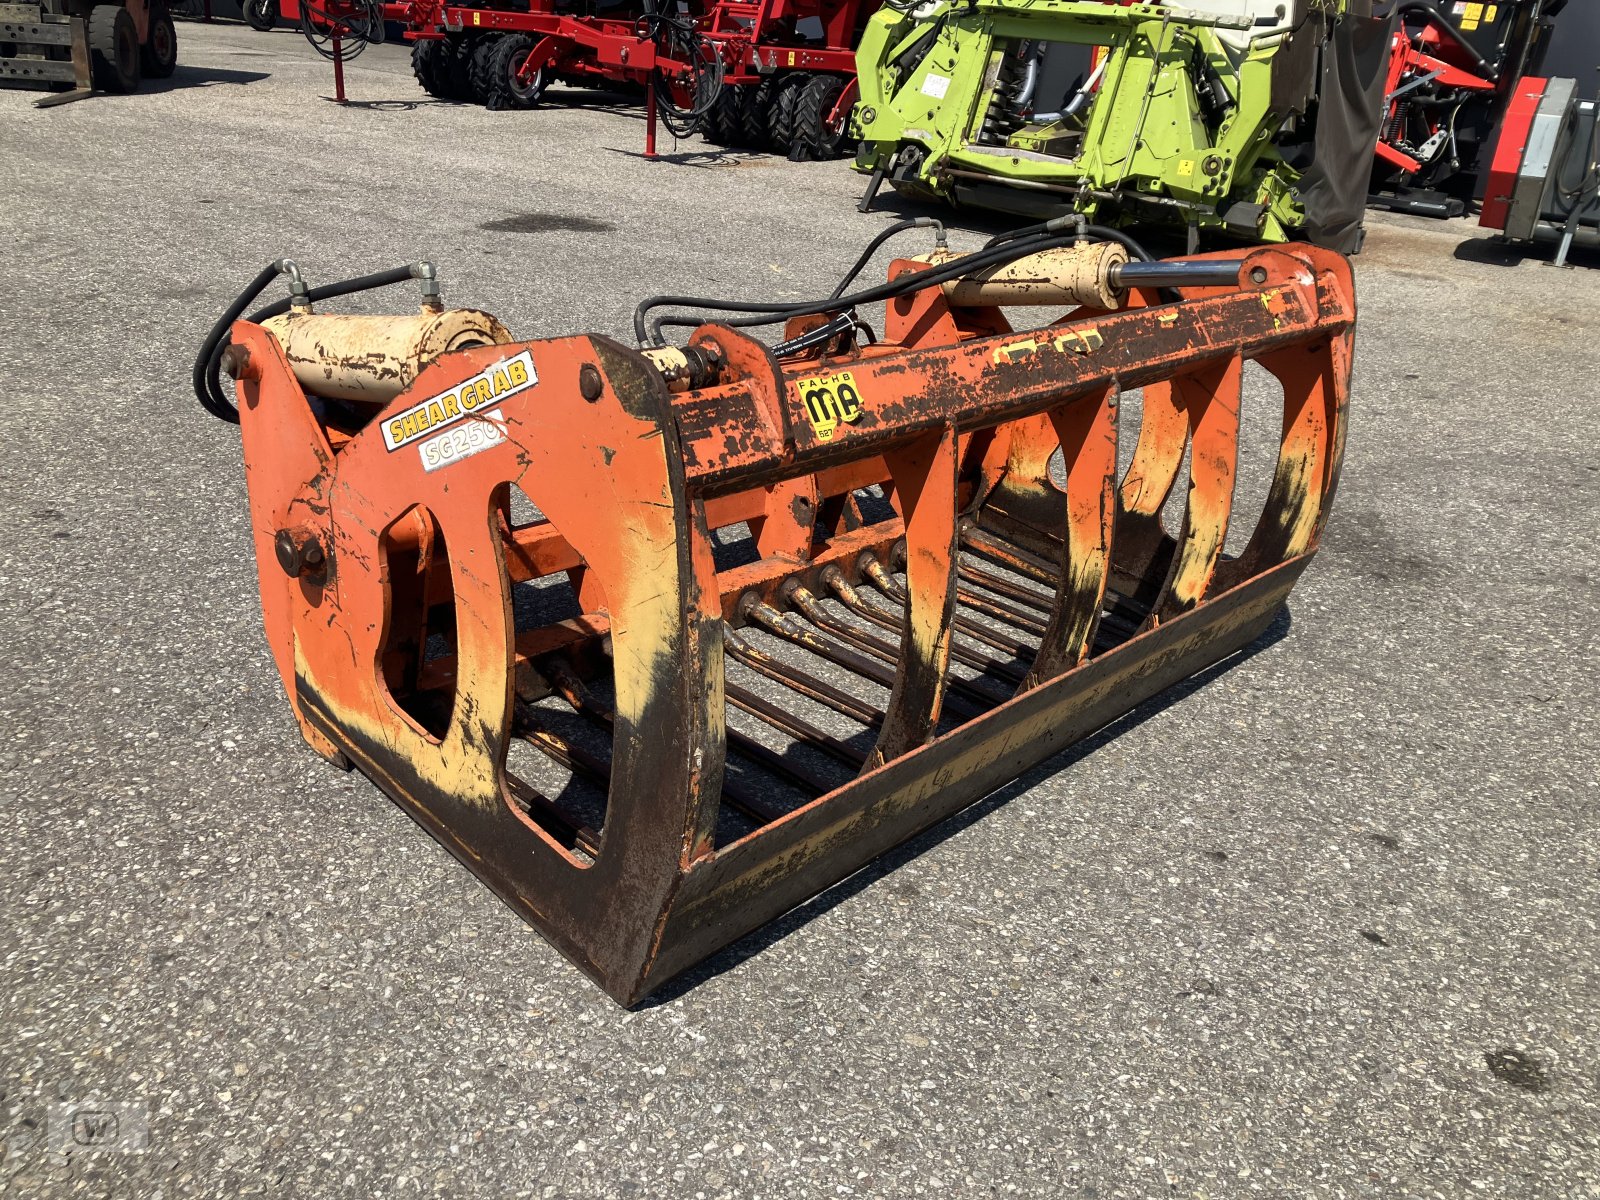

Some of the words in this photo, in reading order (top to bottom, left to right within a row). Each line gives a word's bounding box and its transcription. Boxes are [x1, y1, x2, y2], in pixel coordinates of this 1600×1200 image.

[390, 394, 460, 444] SHEAR
[460, 359, 528, 410] GRAB
[818, 428, 833, 438] 527
